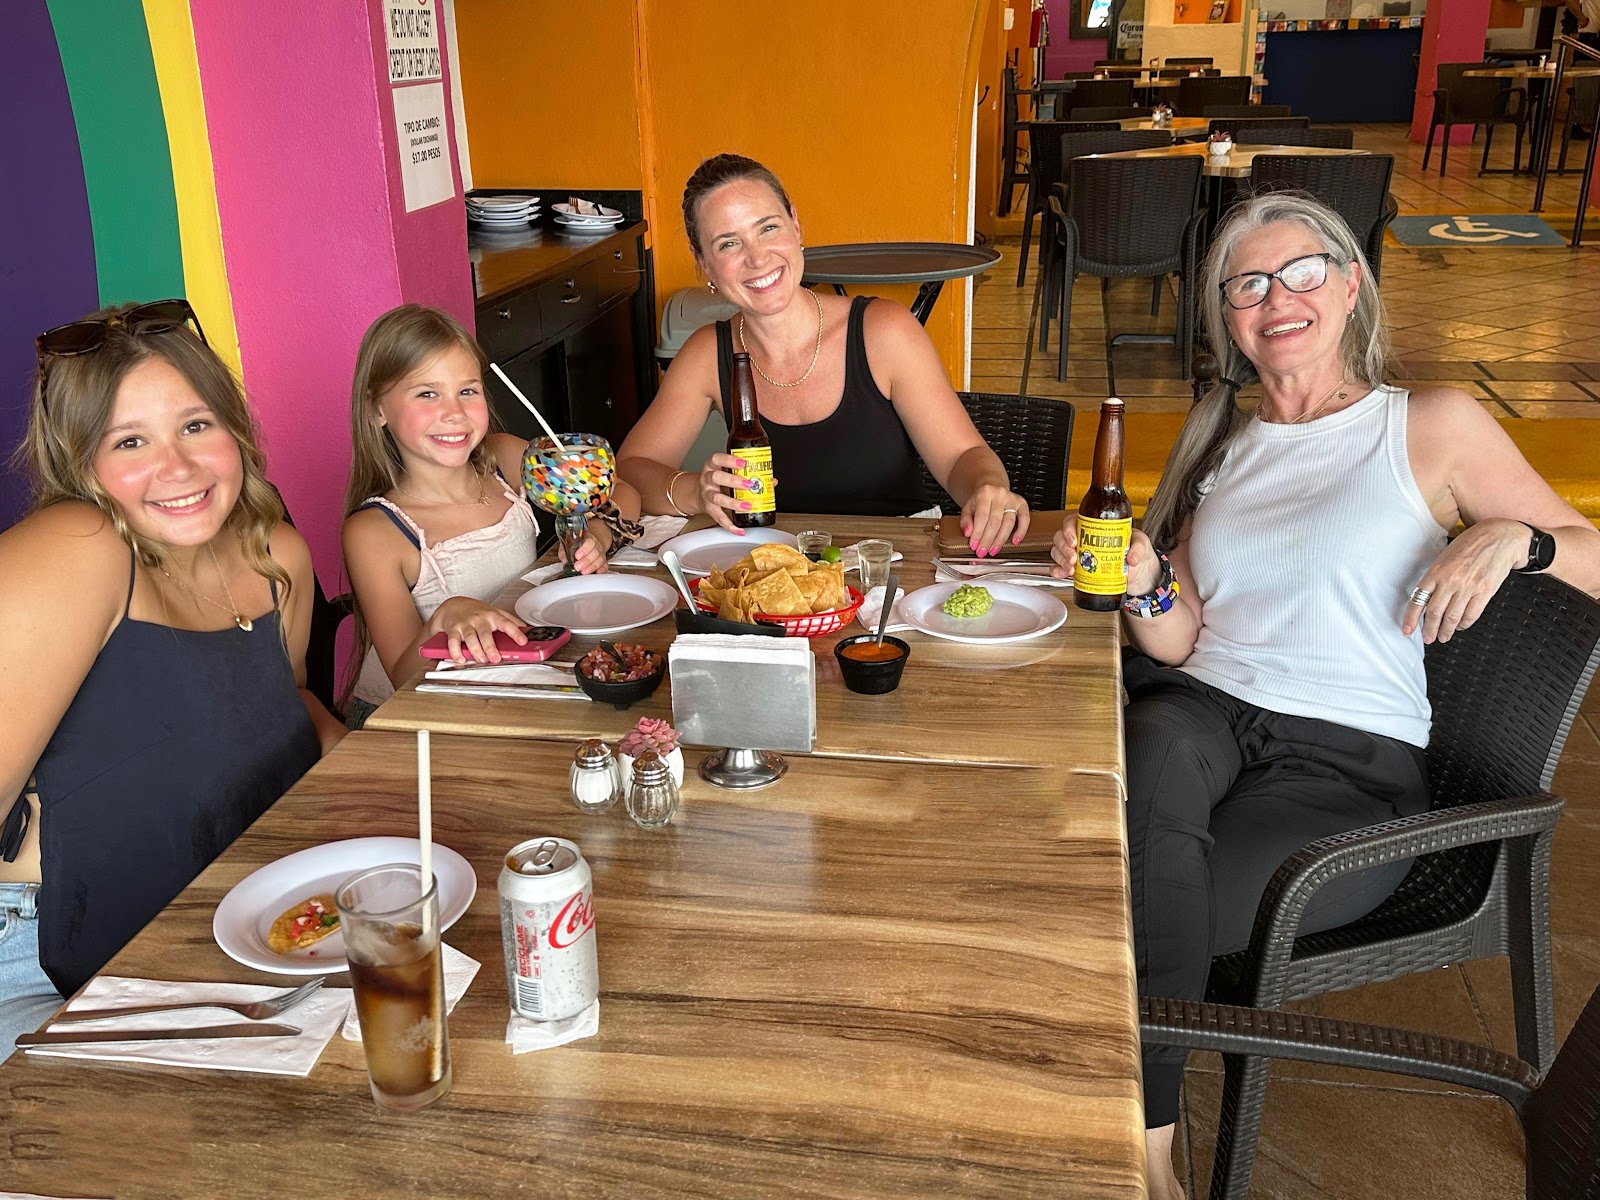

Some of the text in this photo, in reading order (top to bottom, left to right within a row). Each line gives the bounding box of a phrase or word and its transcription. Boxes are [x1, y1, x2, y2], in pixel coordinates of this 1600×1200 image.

[398, 9, 406, 38] DO
[415, 10, 432, 38] ACCEPT
[1120, 23, 1143, 33] Coron
[390, 49, 407, 78] CREDIT
[413, 48, 427, 77] DEBIT
[404, 116, 440, 134] TIPO DE CAMBIO:
[412, 147, 440, 165] $17.00 PESOS
[1079, 528, 1123, 548] PACIFICO
